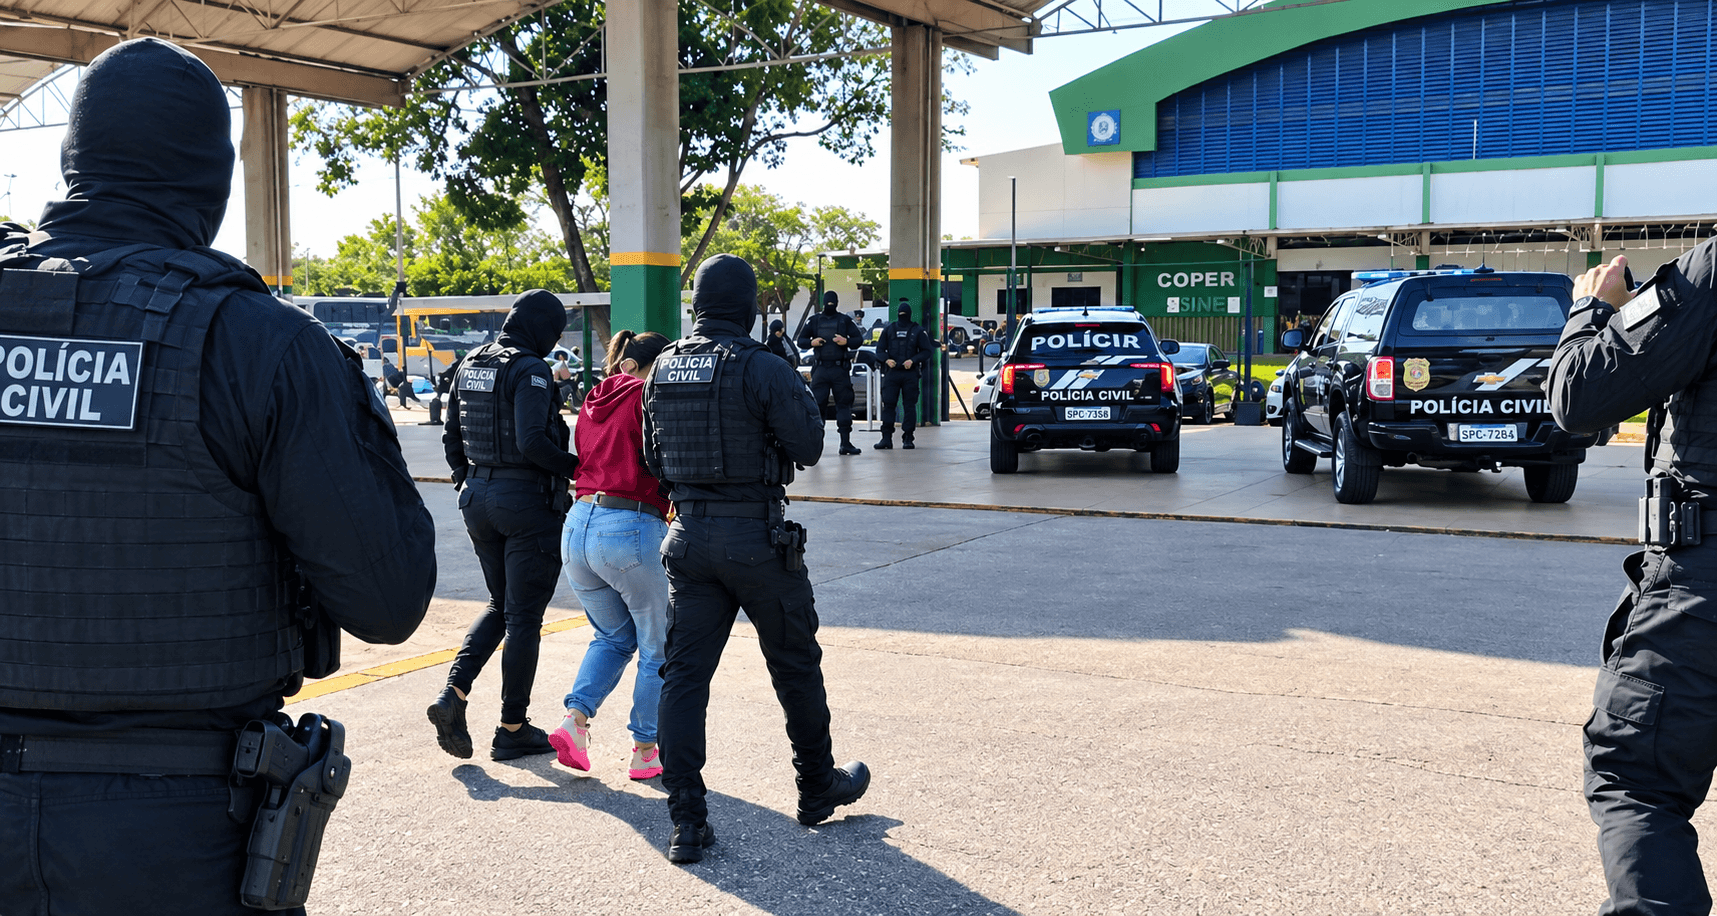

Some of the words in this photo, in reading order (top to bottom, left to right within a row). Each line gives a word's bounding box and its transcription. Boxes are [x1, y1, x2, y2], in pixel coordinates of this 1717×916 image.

[1157, 271, 1235, 288] COPER
[1180, 296, 1226, 312] SINE
[1030, 329, 1141, 351] POLÍCIR
[0, 342, 131, 385] OLÍCIA
[668, 370, 701, 381] CIVIL
[466, 380, 487, 390] CIVIL
[1, 384, 101, 421] CIVIL
[1041, 389, 1095, 401] POLÍCIA
[1098, 390, 1135, 401] CIVIL
[1410, 396, 1494, 414] POLÍCIA
